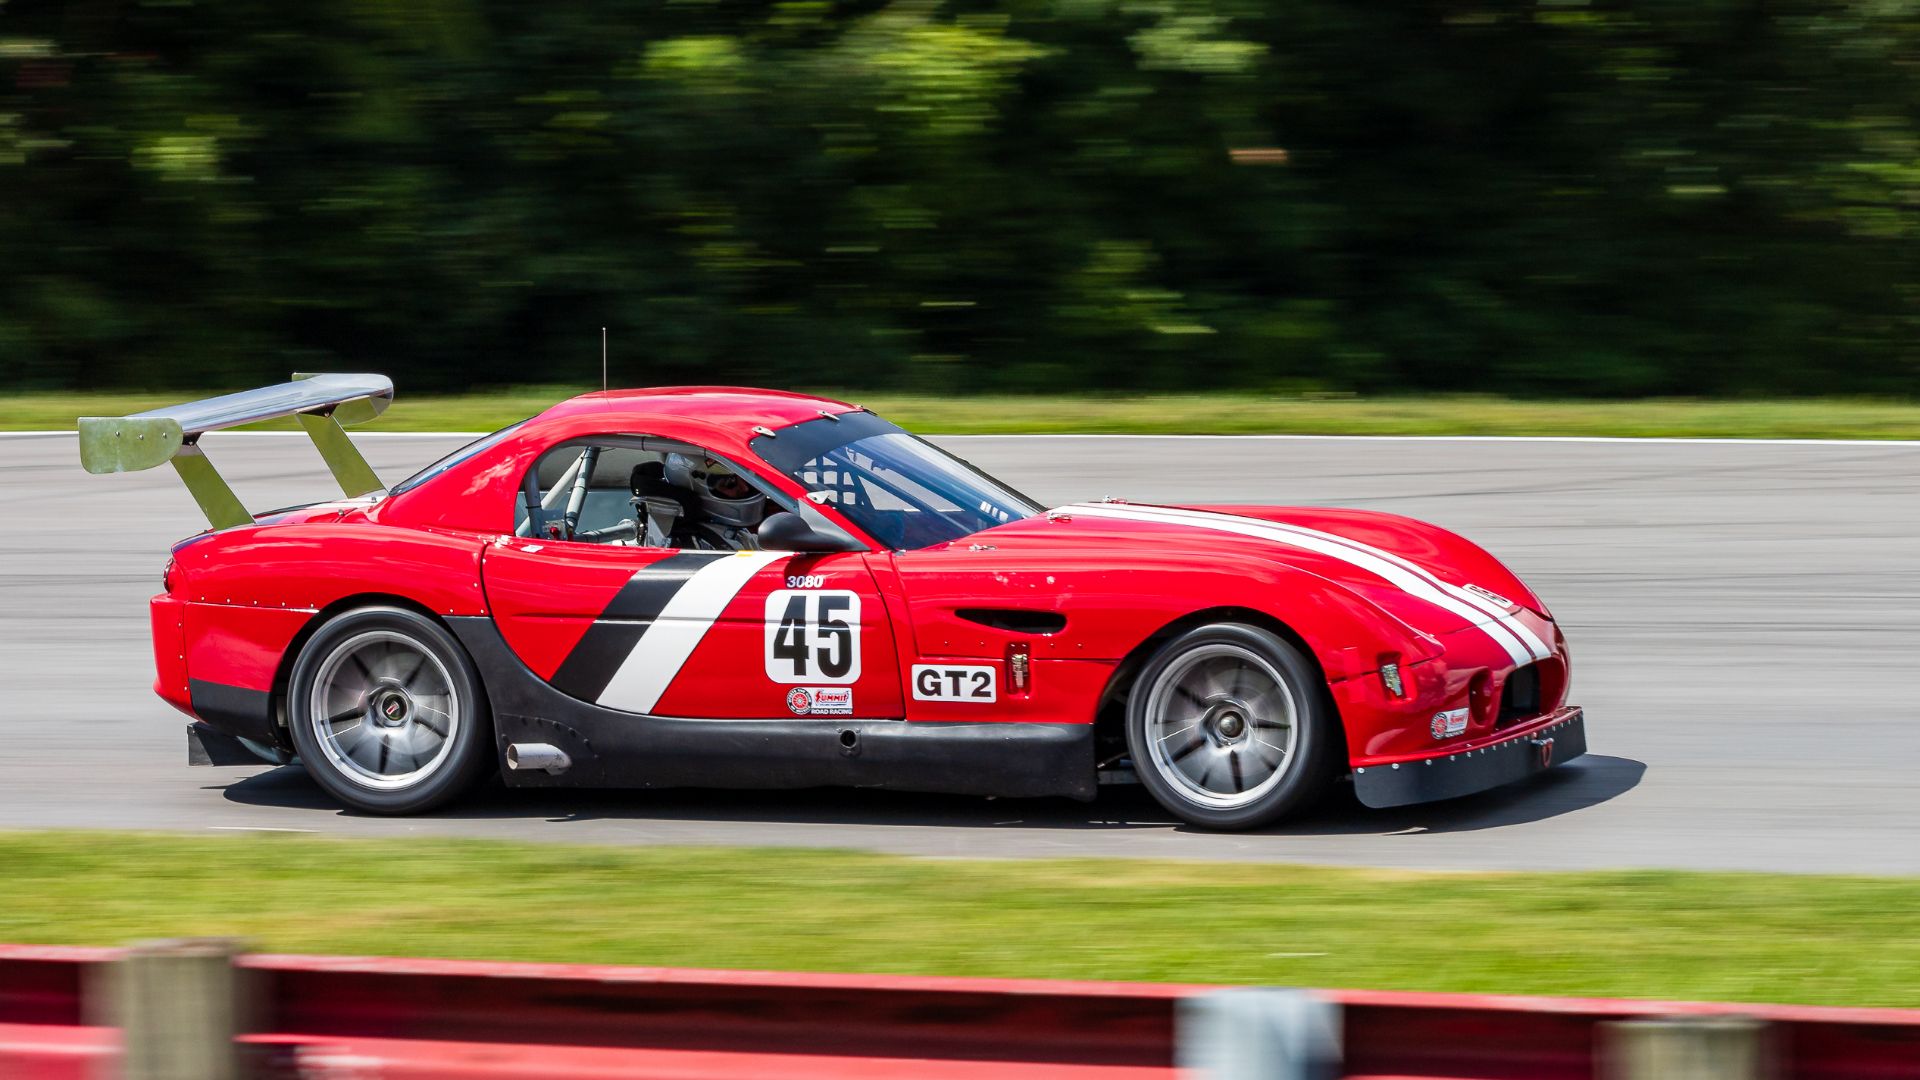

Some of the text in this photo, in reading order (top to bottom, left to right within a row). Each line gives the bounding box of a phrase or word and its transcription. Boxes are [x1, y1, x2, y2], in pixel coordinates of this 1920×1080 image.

[786, 575, 824, 588] 3080
[773, 595, 852, 678] 45
[917, 669, 992, 698] GT2
